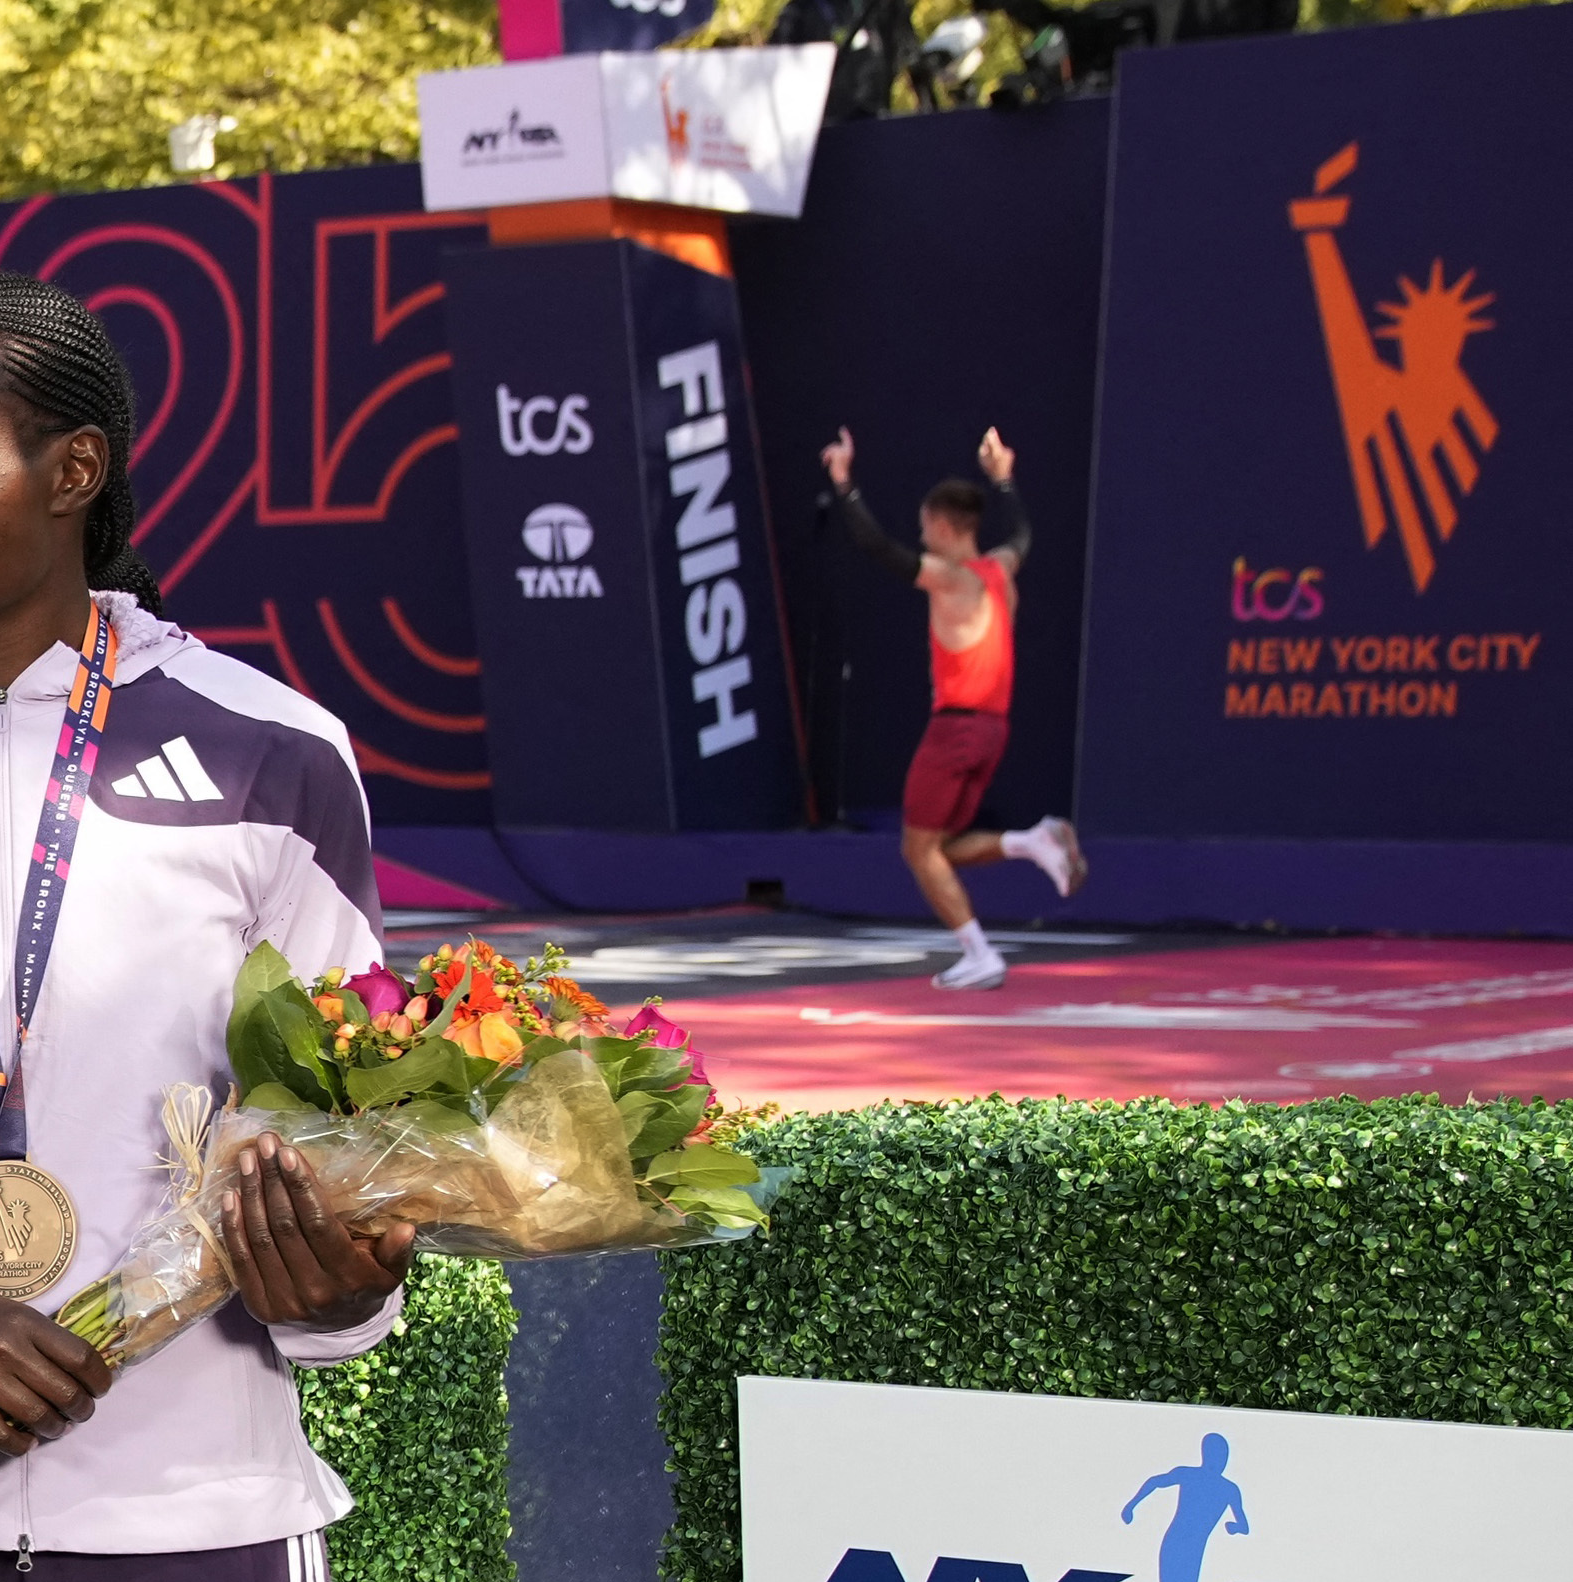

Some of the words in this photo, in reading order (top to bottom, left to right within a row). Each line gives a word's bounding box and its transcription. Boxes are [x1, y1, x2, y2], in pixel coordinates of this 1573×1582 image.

[496, 382, 595, 457] tcs
[658, 340, 758, 760] FINISH
[516, 566, 604, 599] TATA
[1230, 555, 1324, 621] tcs
[1227, 637, 1320, 675] NEW
[1330, 636, 1439, 673] YORK
[1448, 634, 1541, 671] CITY
[73, 671, 100, 745] BROOKLYN
[1223, 681, 1457, 718] MARATHON
[55, 763, 78, 823] QUEENS
[43, 841, 60, 872] THE
[31, 878, 52, 931] BRONX
[5, 1261, 25, 1269] YORK
[26, 1260, 43, 1269] CITY
